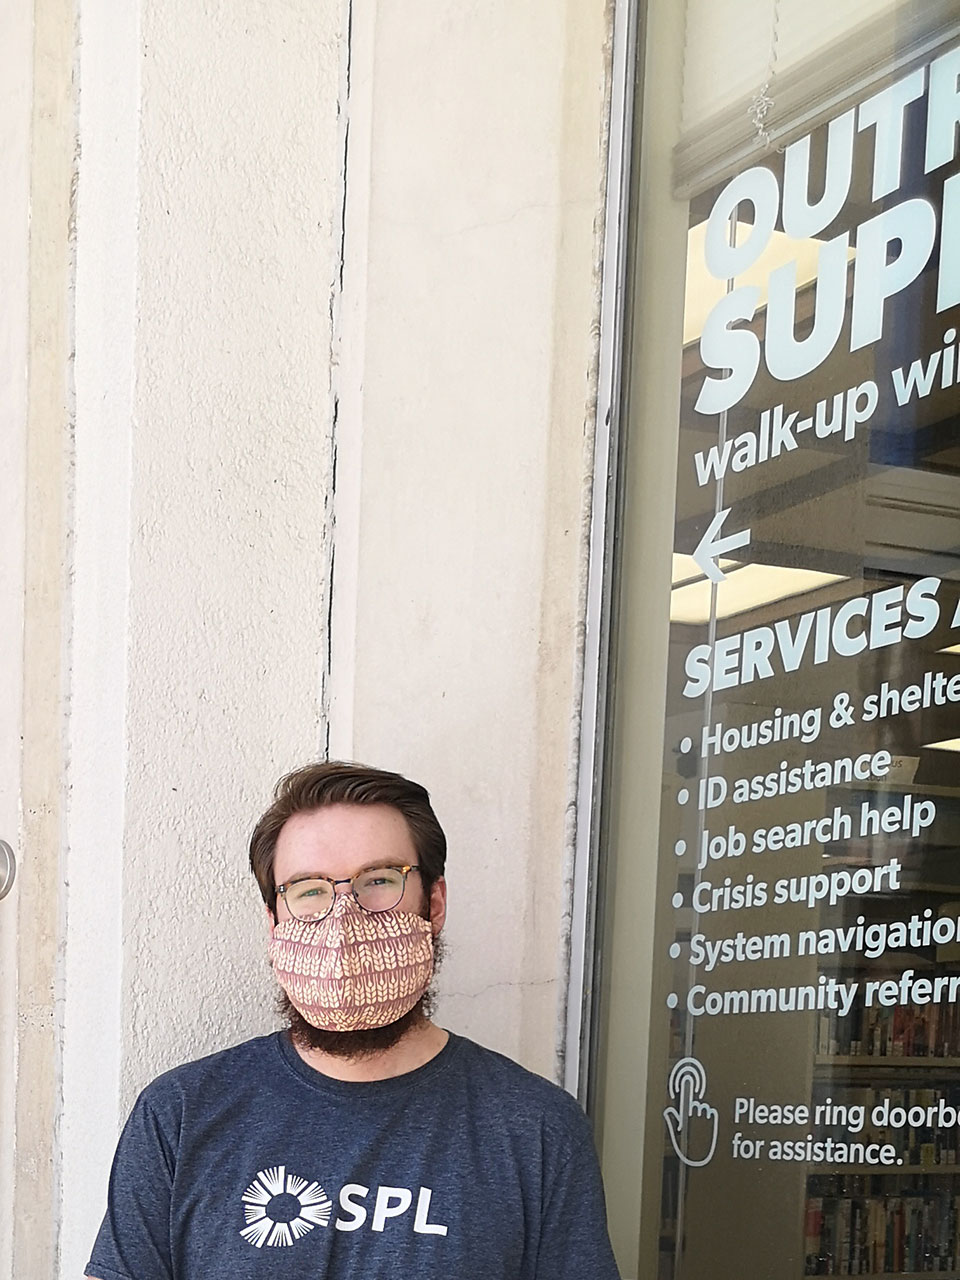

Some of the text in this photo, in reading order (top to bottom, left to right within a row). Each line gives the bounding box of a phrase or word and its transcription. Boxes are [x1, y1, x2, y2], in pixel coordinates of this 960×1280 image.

[694, 328, 960, 486] walk-up wi
[682, 576, 942, 698] SERVICES
[701, 707, 821, 758] Housing
[829, 692, 855, 729] &
[698, 749, 891, 810] ID assistance
[698, 794, 936, 869] Job search help
[692, 858, 901, 913] Crisis support
[689, 908, 960, 971] System navigatio
[687, 976, 858, 1017] Community
[734, 1098, 960, 1133] Please ring doorb
[732, 1132, 903, 1165] for assistance.
[335, 1183, 448, 1236] SPL
